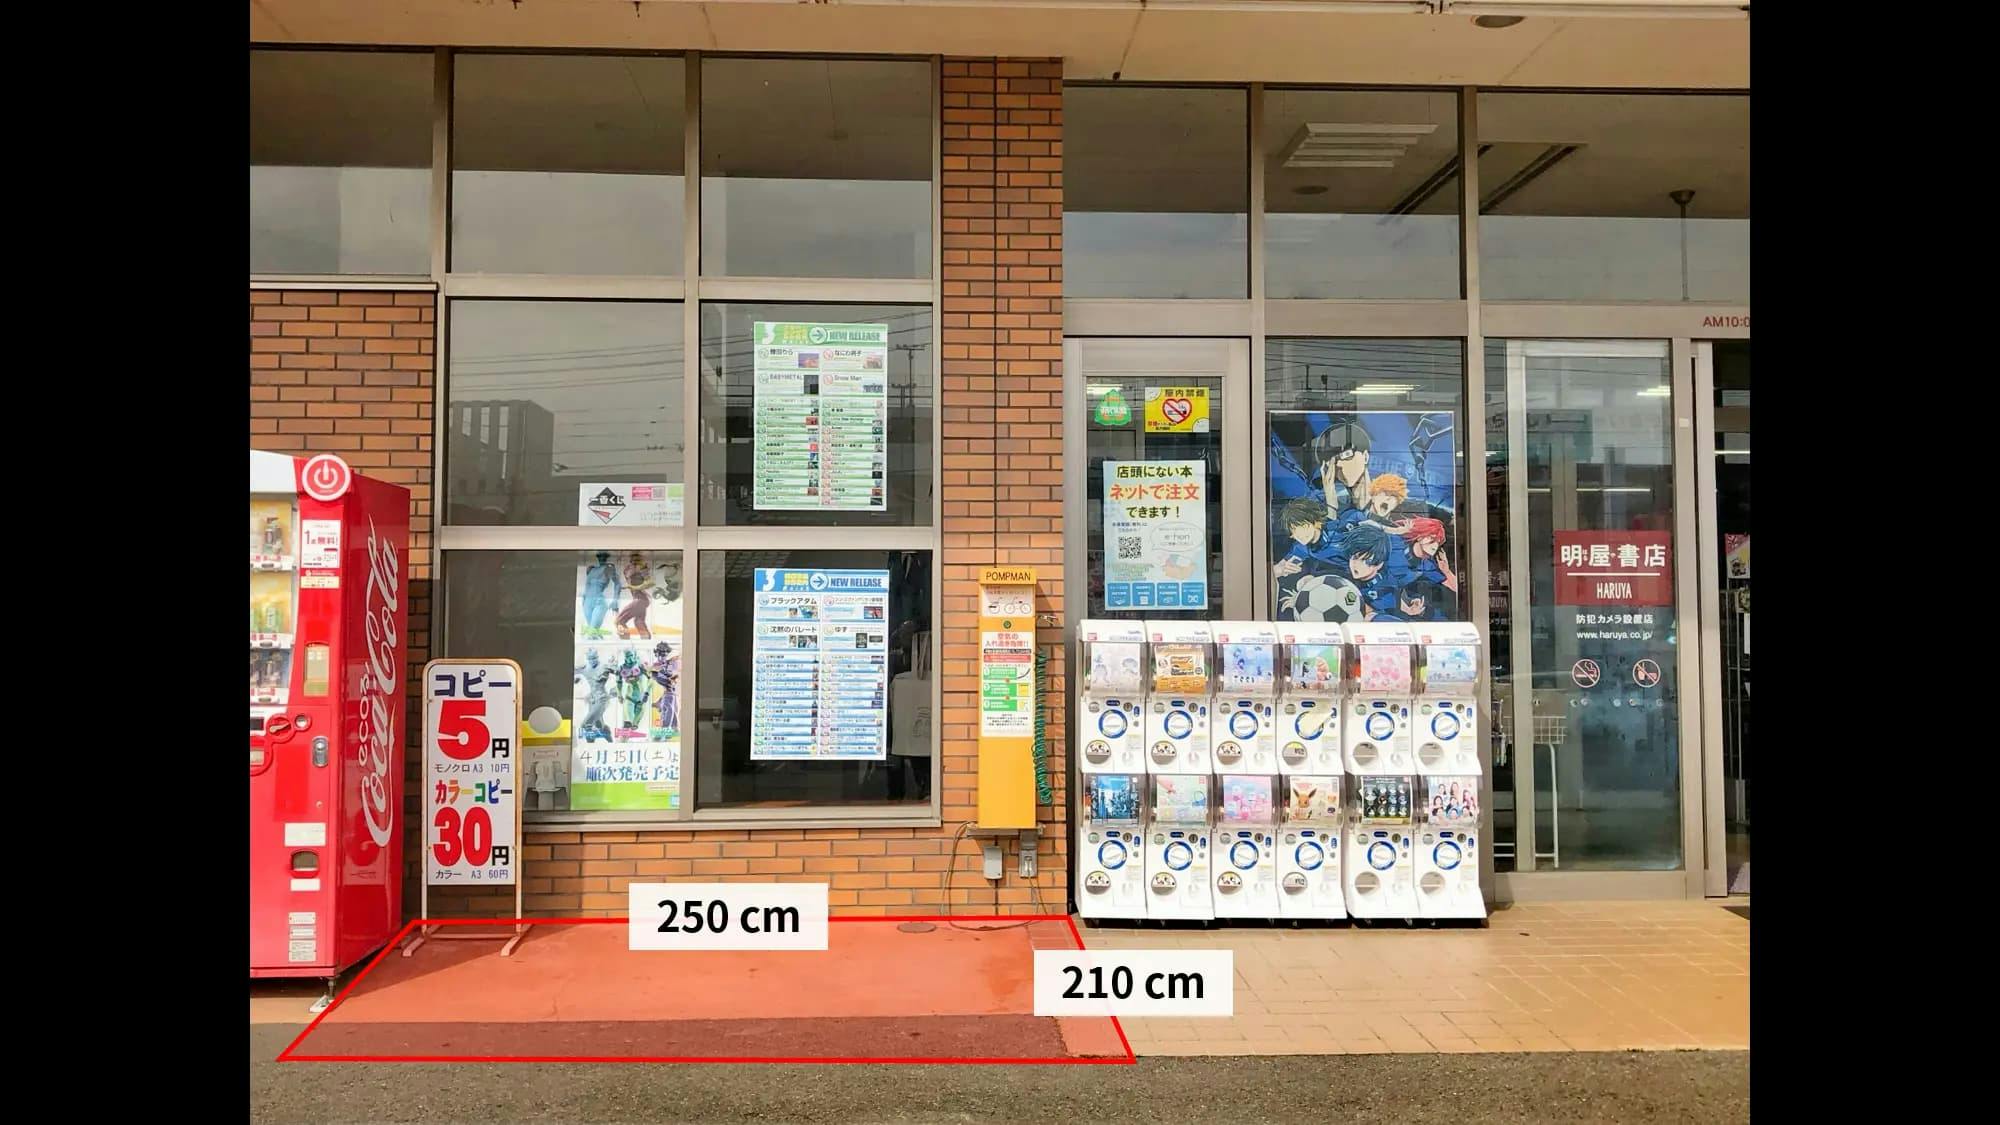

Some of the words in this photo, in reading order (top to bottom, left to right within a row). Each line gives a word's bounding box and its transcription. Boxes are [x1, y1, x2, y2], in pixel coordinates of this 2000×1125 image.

[829, 330, 848, 341] NEW
[1117, 465, 1193, 479] 店頭にない本
[1110, 484, 1200, 500] ネットで注文
[1126, 506, 1180, 518] できます！
[1561, 544, 1666, 568] 明屋書店
[830, 577, 850, 588] NEW
[850, 577, 882, 588] RELEASE
[985, 572, 1031, 581] POMPMAN
[1596, 582, 1632, 599] HARUYA
[1576, 614, 1654, 625] 防犯カメラ設置店
[434, 669, 512, 698] コピー
[435, 763, 470, 774] モノクロ
[472, 763, 484, 774] A3
[490, 763, 510, 774] 10円
[586, 765, 679, 782] 順次発売予定
[435, 779, 513, 804] カラーコピー
[435, 870, 462, 879] カラー
[471, 870, 482, 879] A3
[488, 870, 509, 879] 60円
